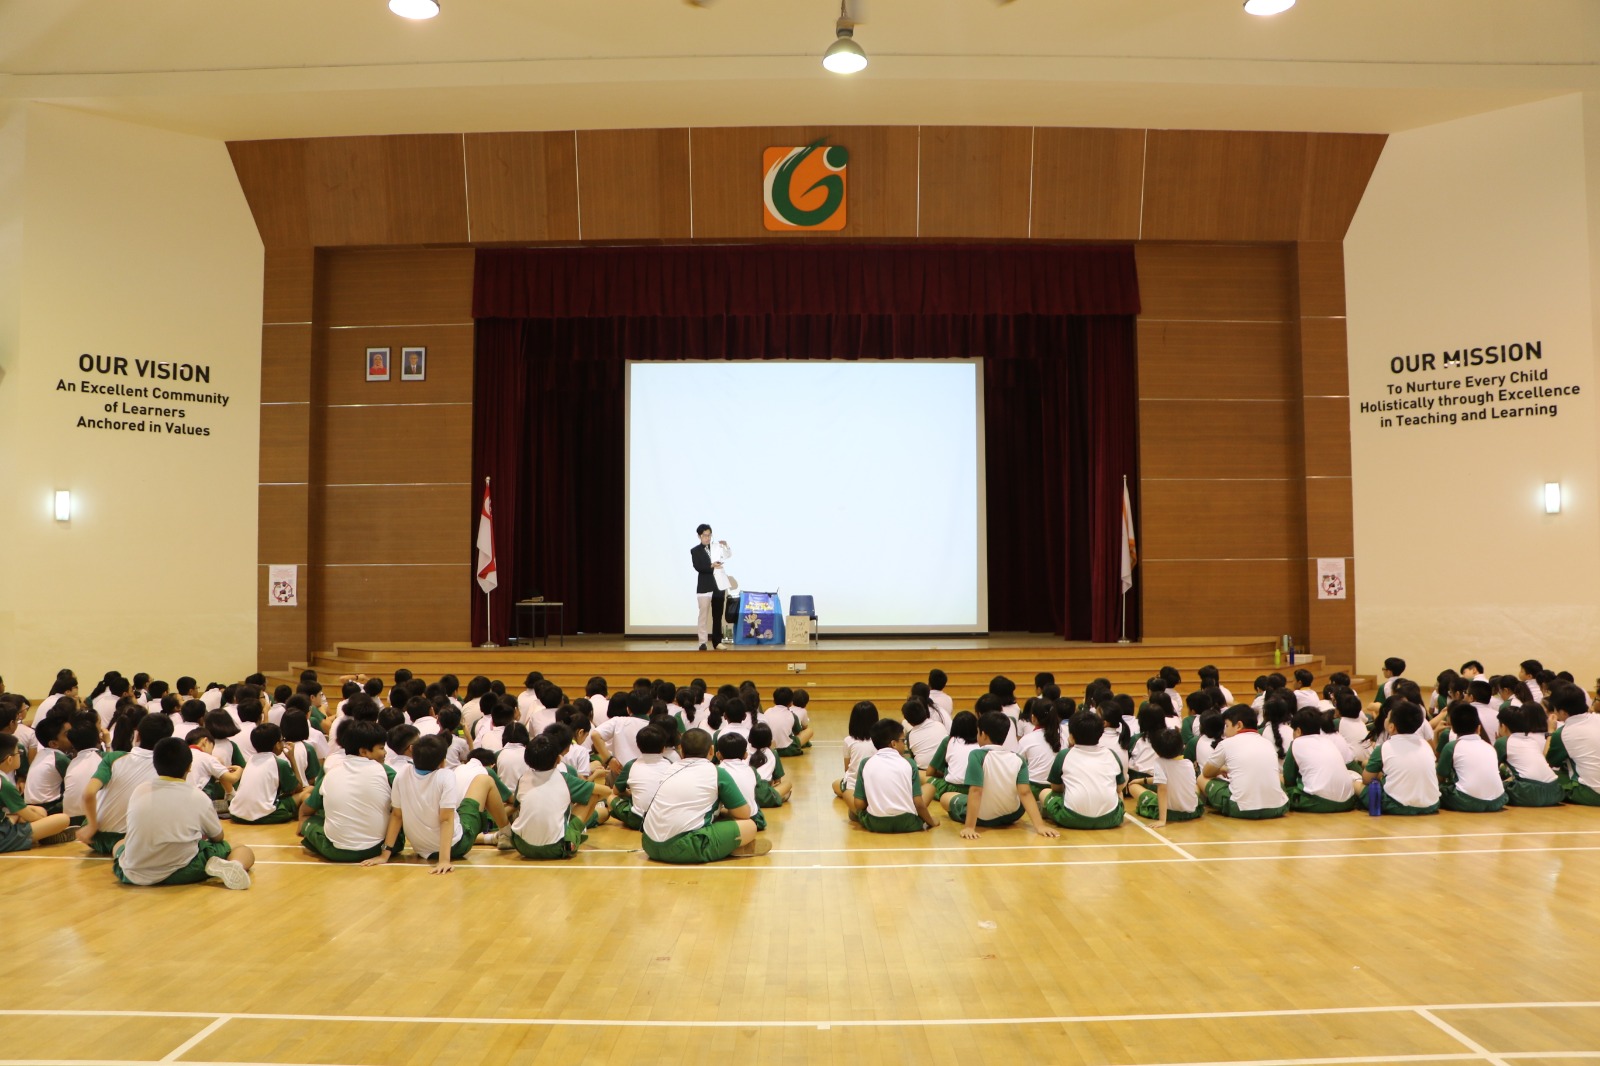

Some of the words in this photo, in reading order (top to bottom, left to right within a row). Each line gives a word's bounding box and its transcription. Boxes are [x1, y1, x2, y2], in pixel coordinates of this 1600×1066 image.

[78, 353, 129, 376] OUR
[134, 358, 211, 384] VISION
[1390, 354, 1436, 375] OUR
[1443, 340, 1542, 369] MISSION
[56, 378, 76, 392] An
[80, 380, 149, 398] Excellent
[152, 387, 230, 408] Community
[1386, 384, 1403, 395] To
[1406, 379, 1461, 394] Nurture
[1465, 375, 1506, 388] Every
[1509, 368, 1548, 384] Child
[104, 401, 119, 413] of
[122, 401, 186, 419] Learners
[1360, 397, 1436, 414] Holistically
[1437, 391, 1494, 407] through
[1498, 385, 1581, 402] Excellence
[76, 415, 145, 432] Anchored
[148, 420, 162, 433] in
[165, 421, 211, 437] Values
[1380, 416, 1393, 428] in
[1395, 411, 1457, 427] Teaching
[1461, 408, 1487, 422] and
[1491, 404, 1558, 419] Learning
